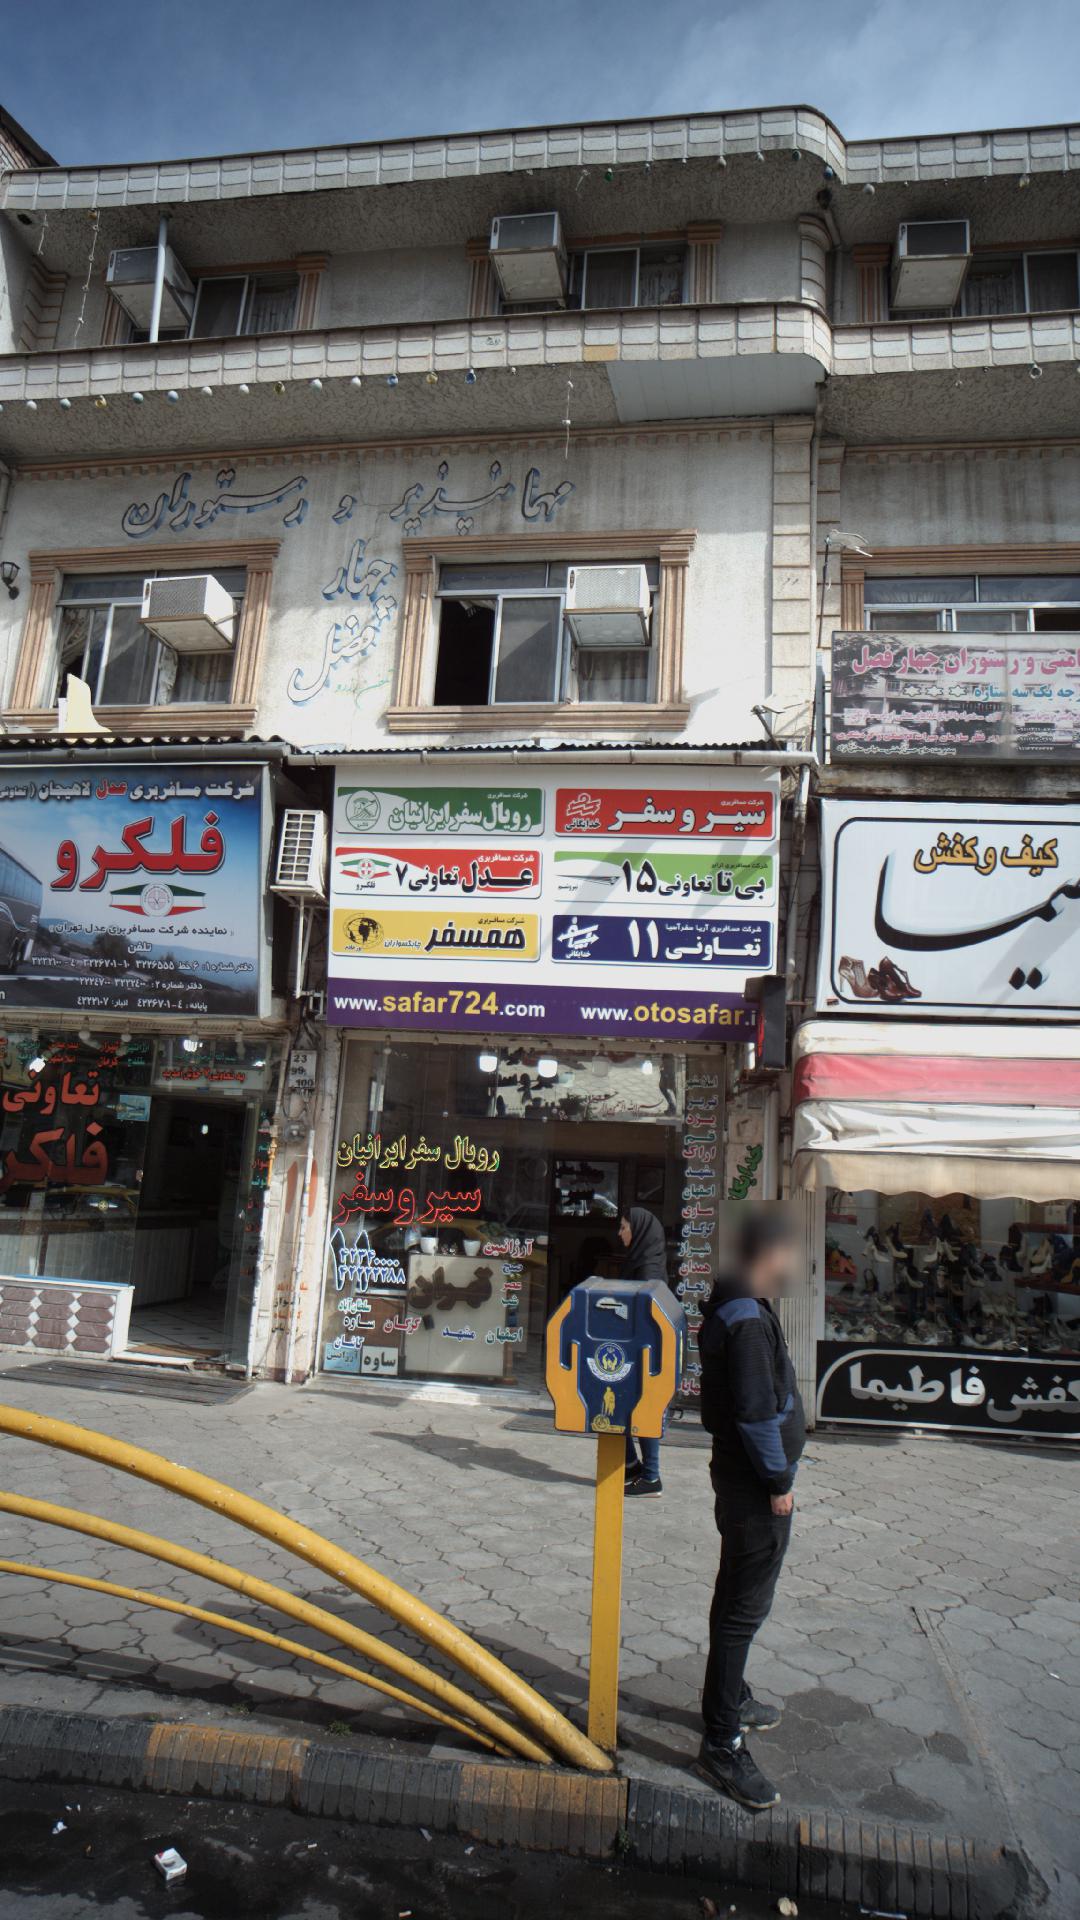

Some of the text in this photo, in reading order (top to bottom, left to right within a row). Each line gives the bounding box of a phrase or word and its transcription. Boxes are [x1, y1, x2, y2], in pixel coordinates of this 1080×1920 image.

[121, 469, 307, 538] رستوران
[332, 494, 357, 524] و
[322, 539, 398, 621] چهار
[287, 613, 378, 707] فصل
[852, 644, 894, 673] فصل
[896, 645, 940, 674] چهار
[943, 646, 1019, 676] رستوران
[1024, 656, 1035, 675] و
[1012, 687, 1029, 698] سه
[38, 780, 91, 800] لاهیجان
[96, 779, 128, 800] عدل
[129, 781, 201, 800] مسافربری
[206, 780, 255, 799] شرکت
[487, 792, 512, 800] مسافربری
[387, 799, 452, 832] ایرانیان
[450, 803, 484, 832] سفر
[482, 800, 532, 832] رویال
[607, 796, 676, 832] سفر
[678, 813, 696, 833] و
[698, 808, 766, 833] سیر
[50, 810, 225, 892] فلکرو
[477, 853, 535, 864] شرکت مسافربری
[913, 831, 1059, 877] کیف و کفش
[395, 861, 533, 893] عدل تعاونی ۷
[621, 859, 766, 900] بی تا تعاونی ۱۵
[55, 923, 228, 937] نماینده شرکت مسافربری عدل تهران
[478, 916, 506, 925] مسافربری
[710, 924, 741, 934] مسافربری
[742, 924, 762, 934] شرکت
[424, 921, 526, 952] همسفر
[628, 919, 660, 959] ۱۱
[127, 942, 152, 954] تلفن
[665, 937, 762, 961] تعاونی
[178, 962, 192, 971] خط
[211, 963, 236, 973] شماره
[234, 963, 254, 974] دفتر
[161, 980, 185, 990] شماره
[185, 981, 203, 990] دفتر
[333, 990, 546, 1018] www.safar724.com
[580, 1002, 757, 1026] www.otosafar.i
[2, 1070, 100, 1114] تعاونی
[687, 1095, 718, 1110] تبریز
[686, 1113, 717, 1128] یزد
[684, 1129, 717, 1144] قم
[0, 1120, 109, 1194] فلکر
[336, 1133, 500, 1171] رویال سفر ایرانیان
[682, 1145, 717, 1162] اراک
[685, 1165, 715, 1180] مشهد
[333, 1171, 482, 1225] سیر و سفر
[682, 1184, 716, 1201] اصفهان
[681, 1201, 715, 1219] ساری
[678, 1240, 712, 1258] شیراز
[501, 1263, 524, 1275] صبح
[678, 1259, 712, 1277] همدان
[676, 1278, 712, 1302] زنجان
[501, 1294, 519, 1309] شب
[343, 1314, 375, 1331] ساوه
[333, 1334, 365, 1349] کاشان
[442, 1325, 524, 1345] اصفهان مشهد
[363, 1351, 397, 1371] ساوه
